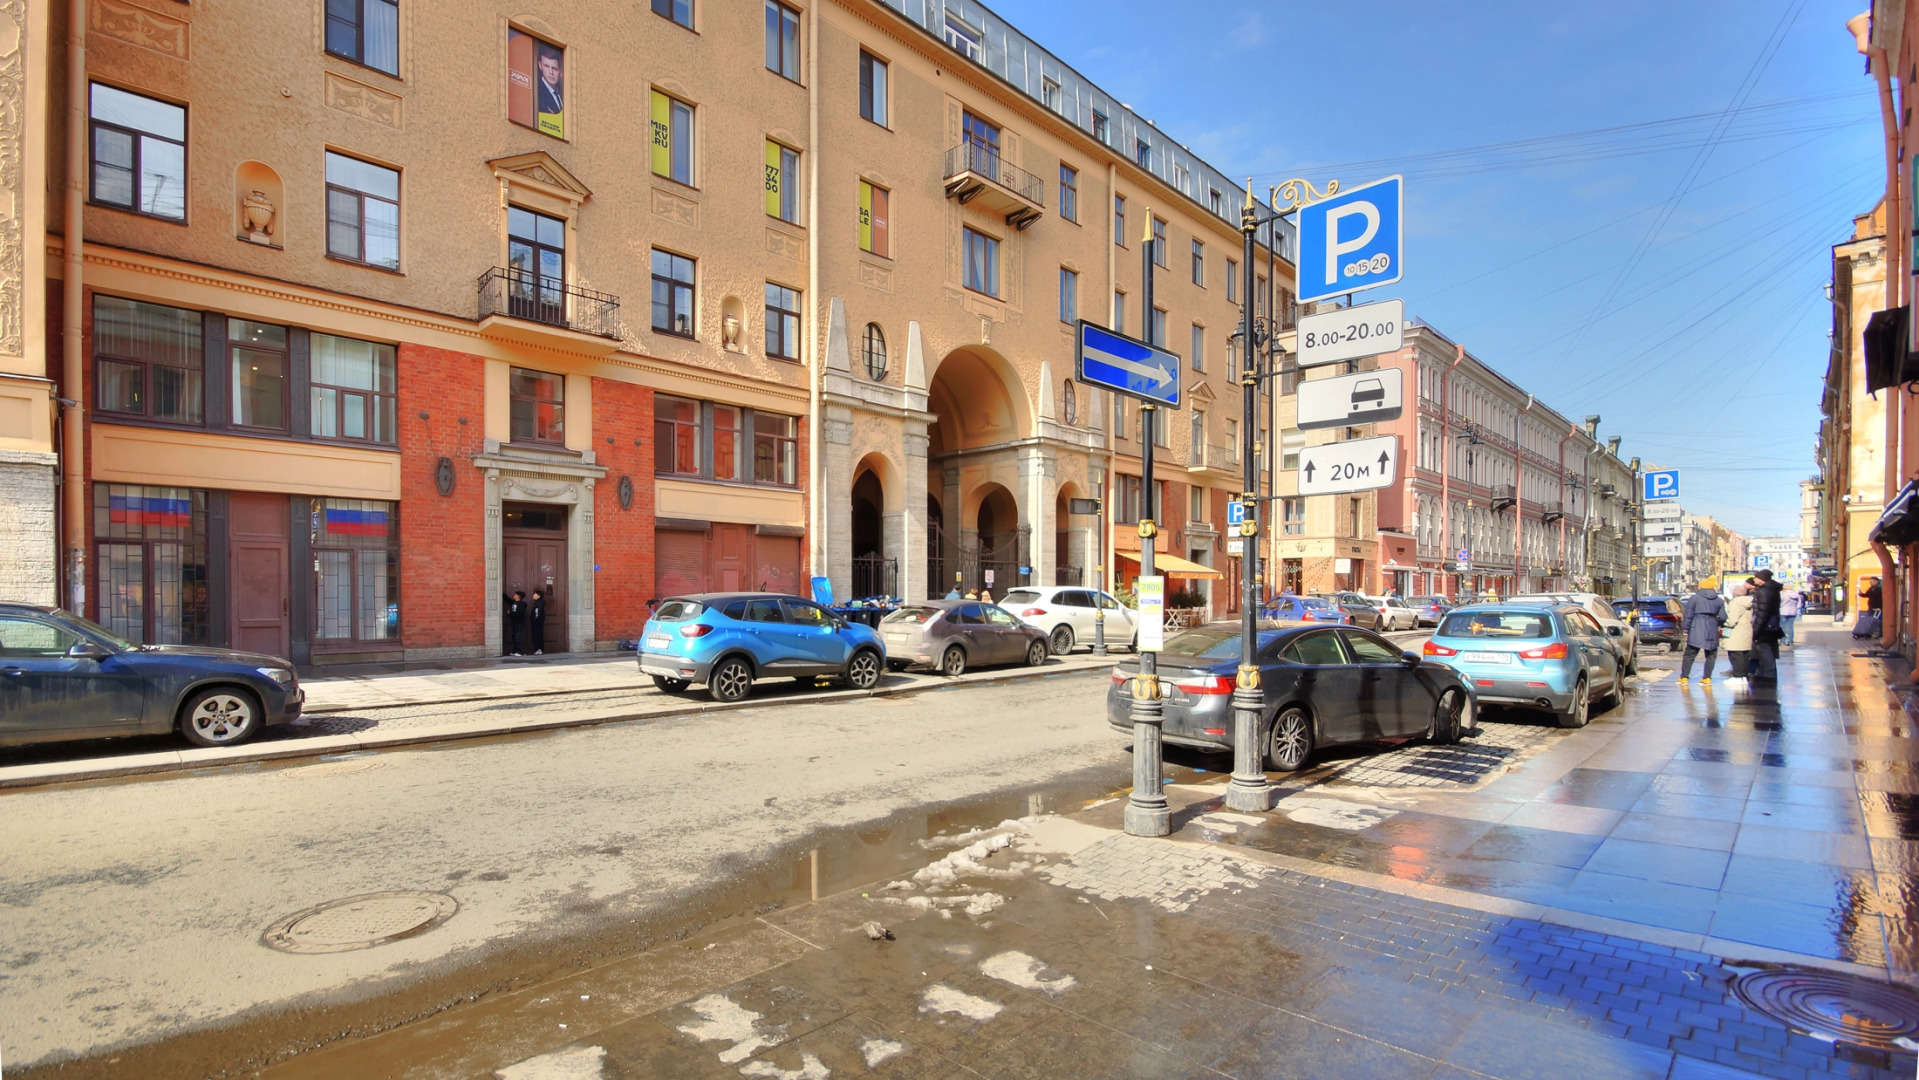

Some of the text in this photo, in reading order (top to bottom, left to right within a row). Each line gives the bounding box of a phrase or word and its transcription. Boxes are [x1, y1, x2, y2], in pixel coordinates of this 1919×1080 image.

[651, 120, 668, 132] MIR
[655, 129, 668, 140] KV
[652, 137, 668, 148] .RU
[766, 173, 778, 184] 34
[1325, 200, 1380, 285] P
[1359, 262, 1368, 272] 15
[1371, 257, 1388, 270] 20
[1305, 321, 1395, 349] 8.00-20.00
[1654, 473, 1674, 497] P
